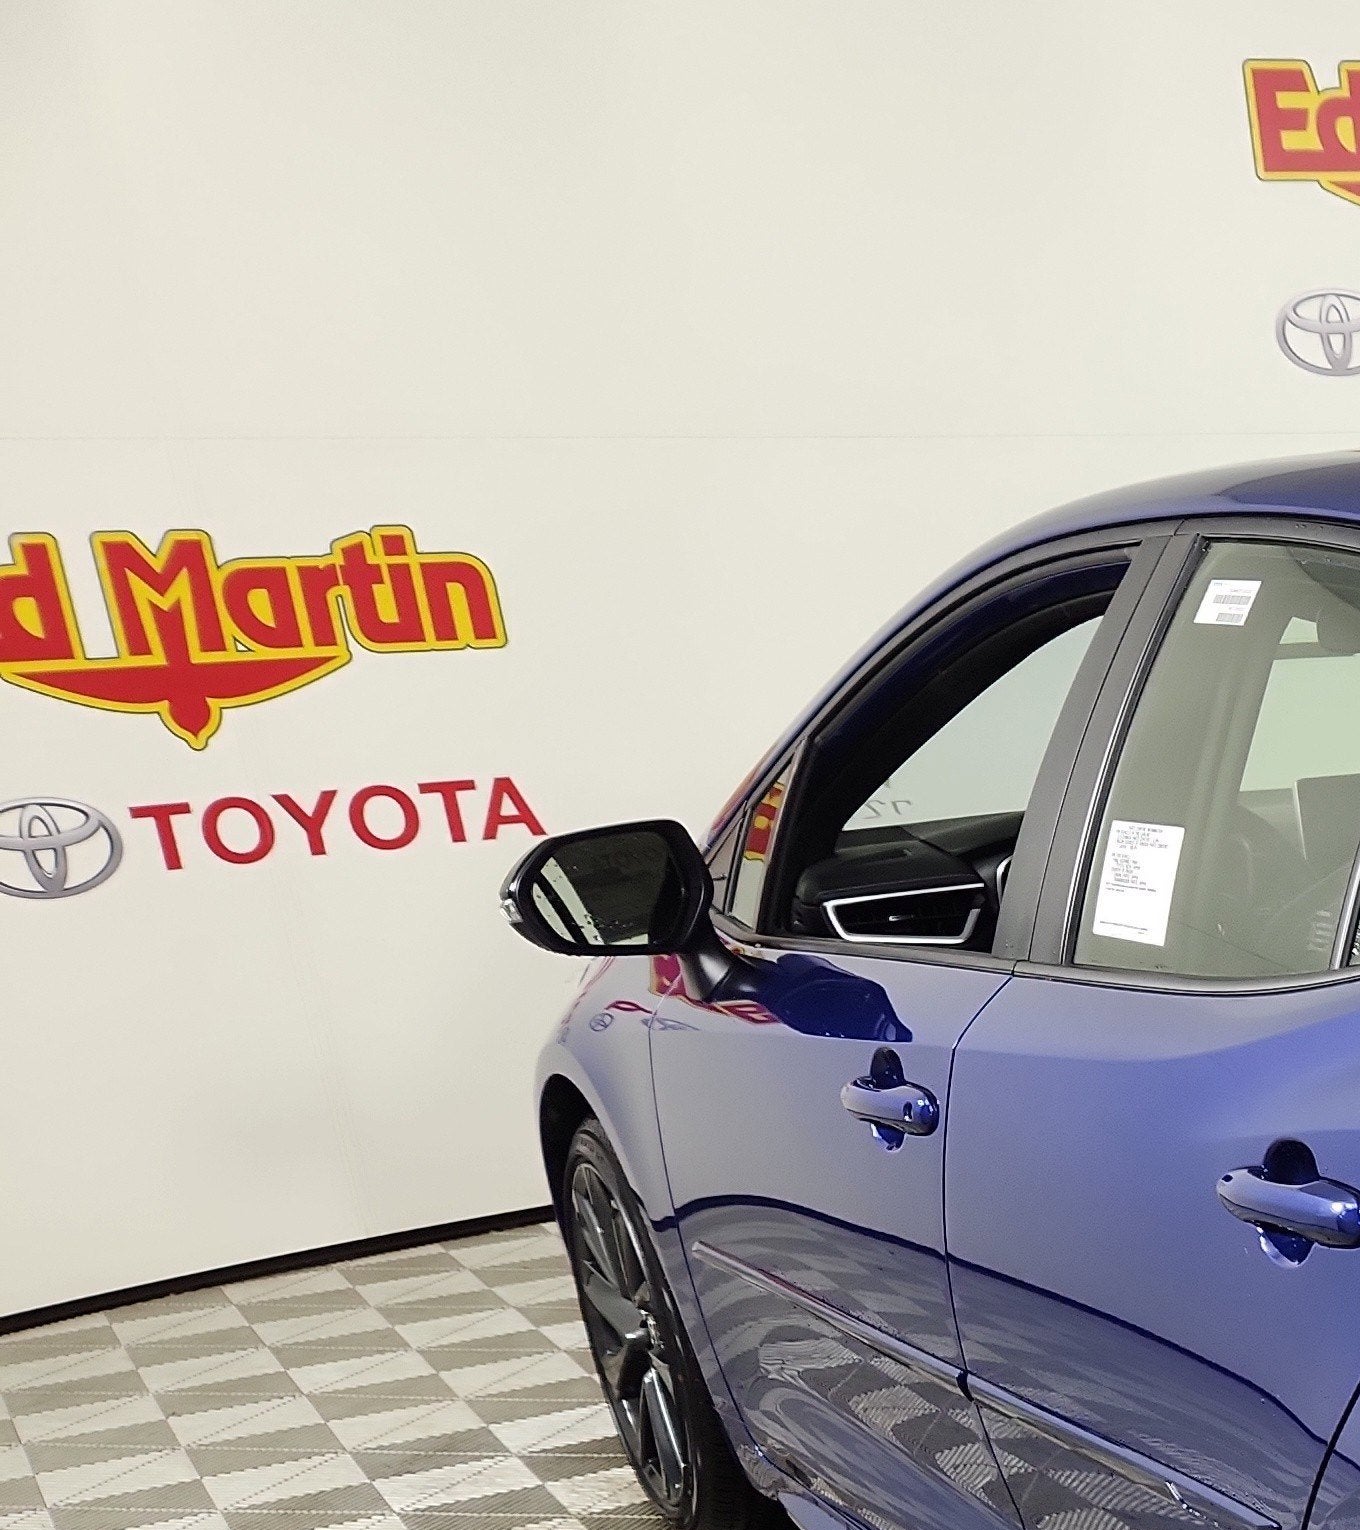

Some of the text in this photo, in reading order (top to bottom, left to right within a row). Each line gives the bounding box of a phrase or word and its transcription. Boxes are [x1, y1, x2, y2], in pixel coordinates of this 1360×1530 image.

[0, 527, 506, 663] d Martin
[130, 775, 547, 871] TOYOTA
